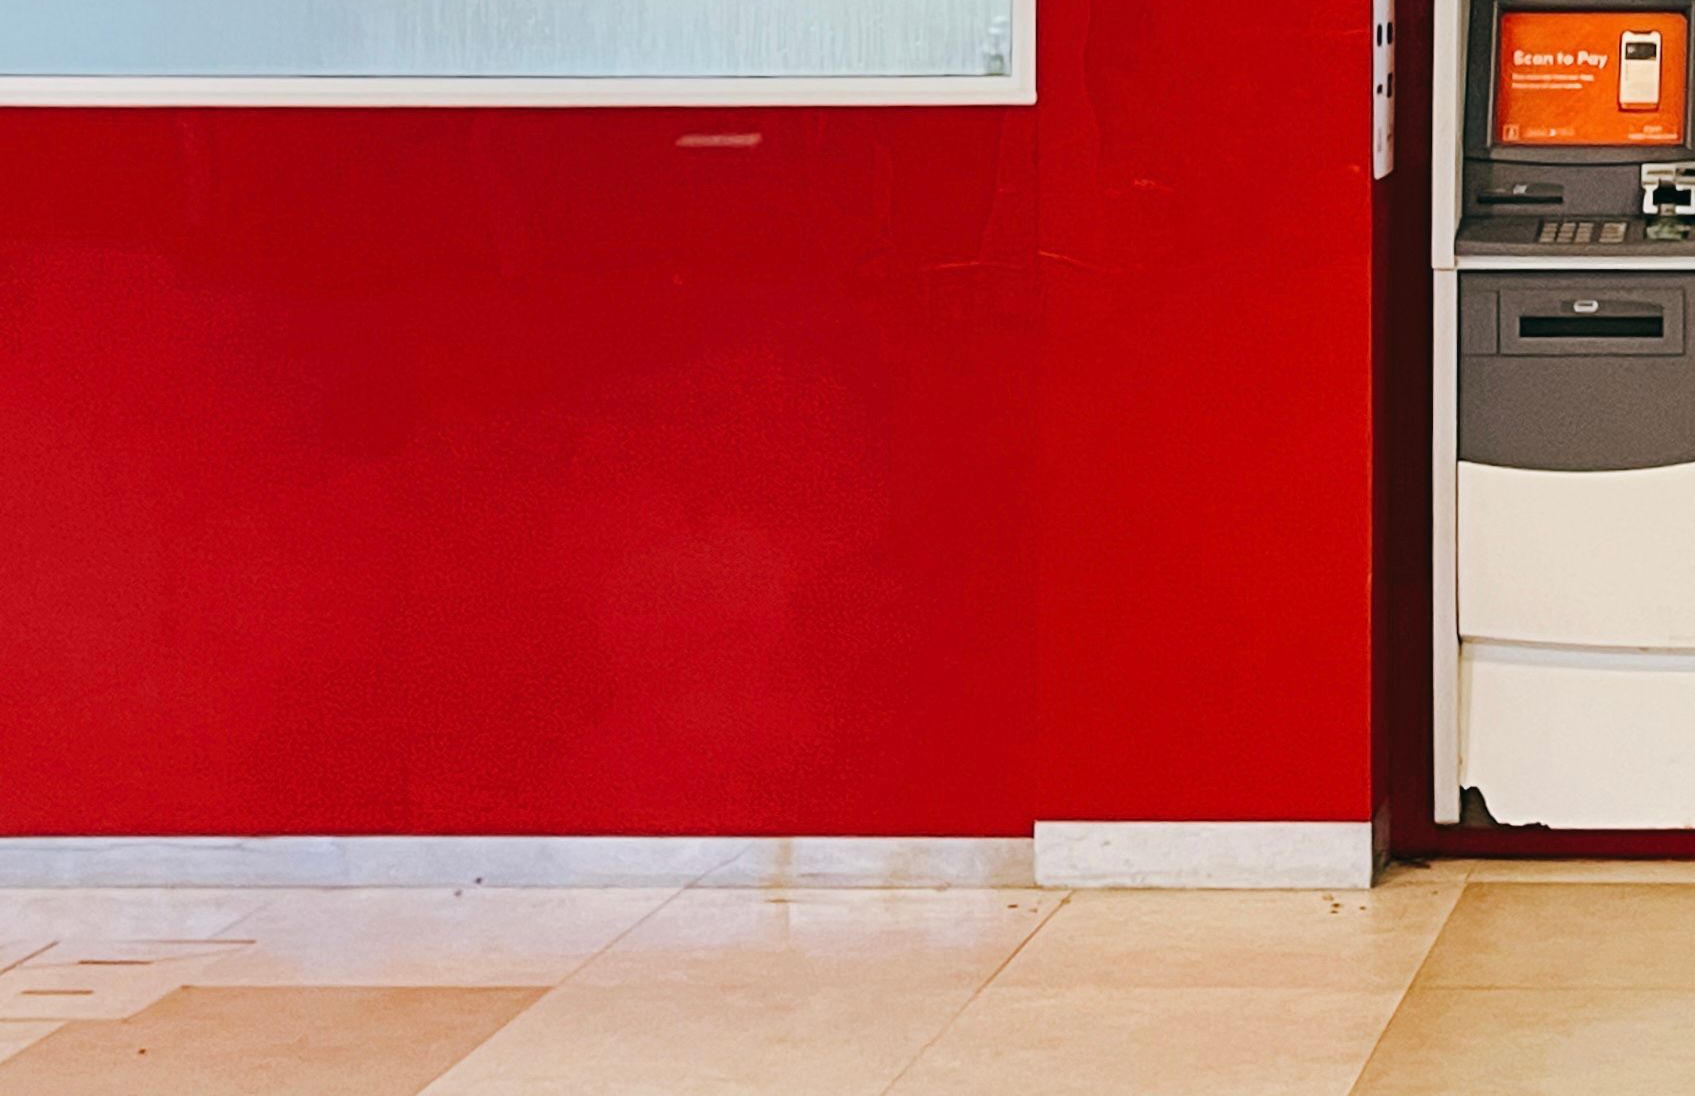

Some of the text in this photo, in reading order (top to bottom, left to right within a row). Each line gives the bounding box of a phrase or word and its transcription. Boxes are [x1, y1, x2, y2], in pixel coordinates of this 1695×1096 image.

[1513, 50, 1608, 69] Scan to Pay
